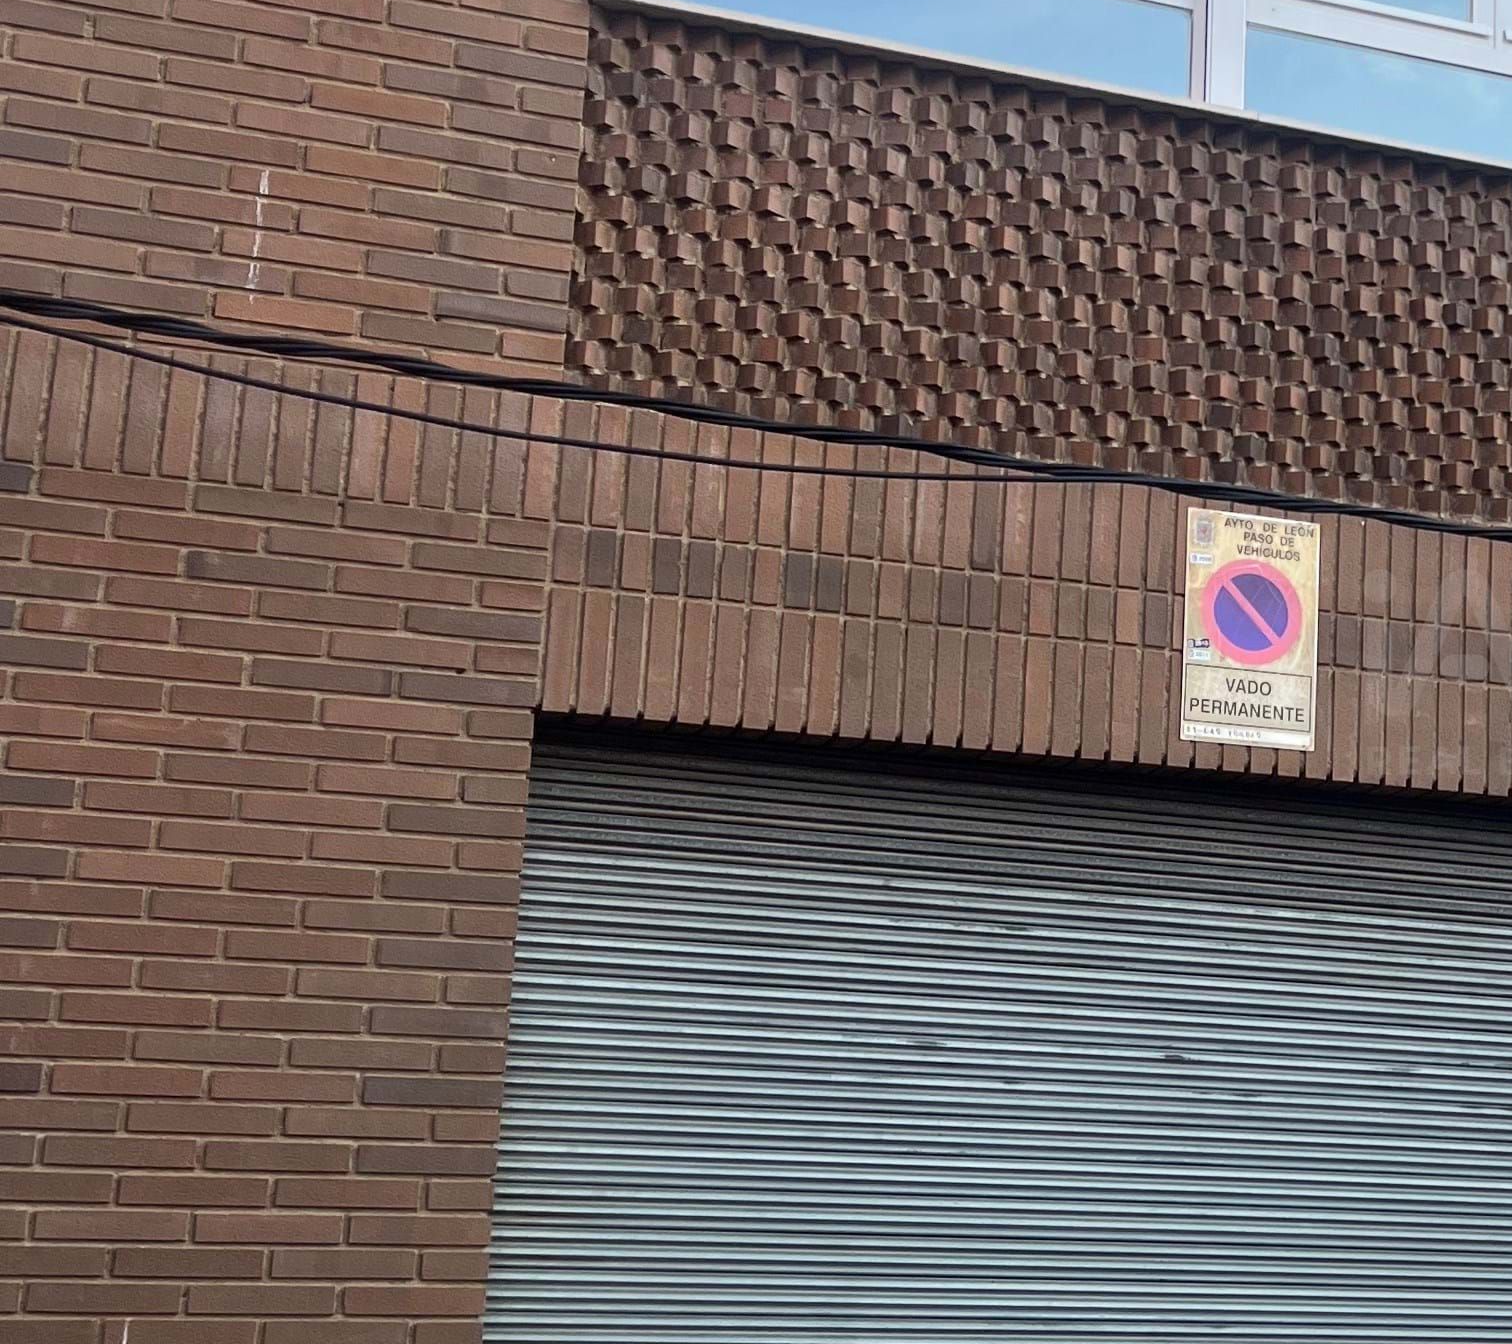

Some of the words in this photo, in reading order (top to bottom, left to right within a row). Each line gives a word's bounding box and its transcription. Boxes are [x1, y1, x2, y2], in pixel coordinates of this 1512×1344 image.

[1262, 522, 1278, 534] DE
[1243, 532, 1273, 544] PASO
[1280, 536, 1295, 547] DE
[1226, 677, 1272, 696] VADO
[1189, 697, 1305, 723] PERMANENTE
